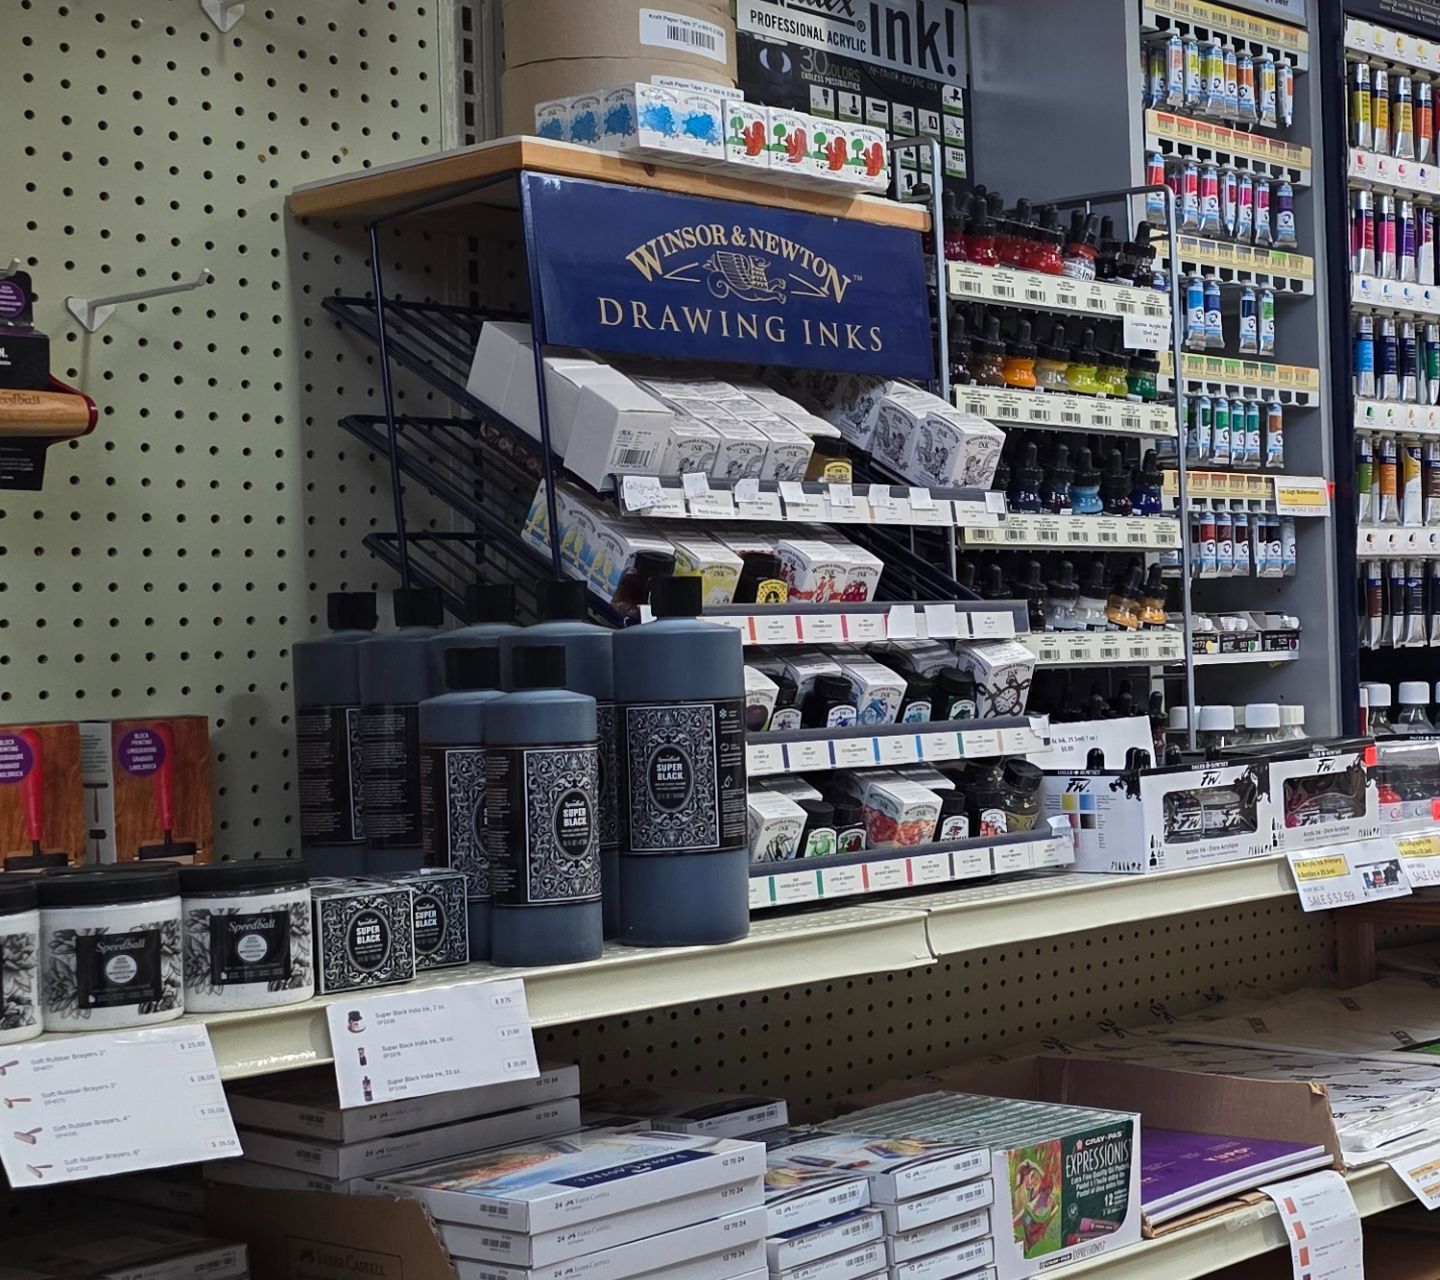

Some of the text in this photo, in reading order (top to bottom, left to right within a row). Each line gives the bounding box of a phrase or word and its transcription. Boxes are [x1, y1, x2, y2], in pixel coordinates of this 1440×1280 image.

[750, 9, 867, 54] PROFESSIONAL ACRYLIC
[800, 47, 828, 73] 30
[625, 224, 851, 304] WINSOR & NEWTON
[597, 296, 883, 352] DRAWING INKS
[656, 762, 683, 773] SUPER
[657, 771, 684, 782] BLACK
[563, 806, 587, 818] SUPER
[563, 815, 587, 827] BLACK
[415, 909, 437, 920] SUPER
[228, 917, 275, 934] Speedball
[415, 917, 438, 929] BLACK
[356, 924, 381, 936] SUPER
[356, 933, 381, 945] BLACK
[95, 937, 145, 955] Speedball
[1104, 1193, 1114, 1208] 12
